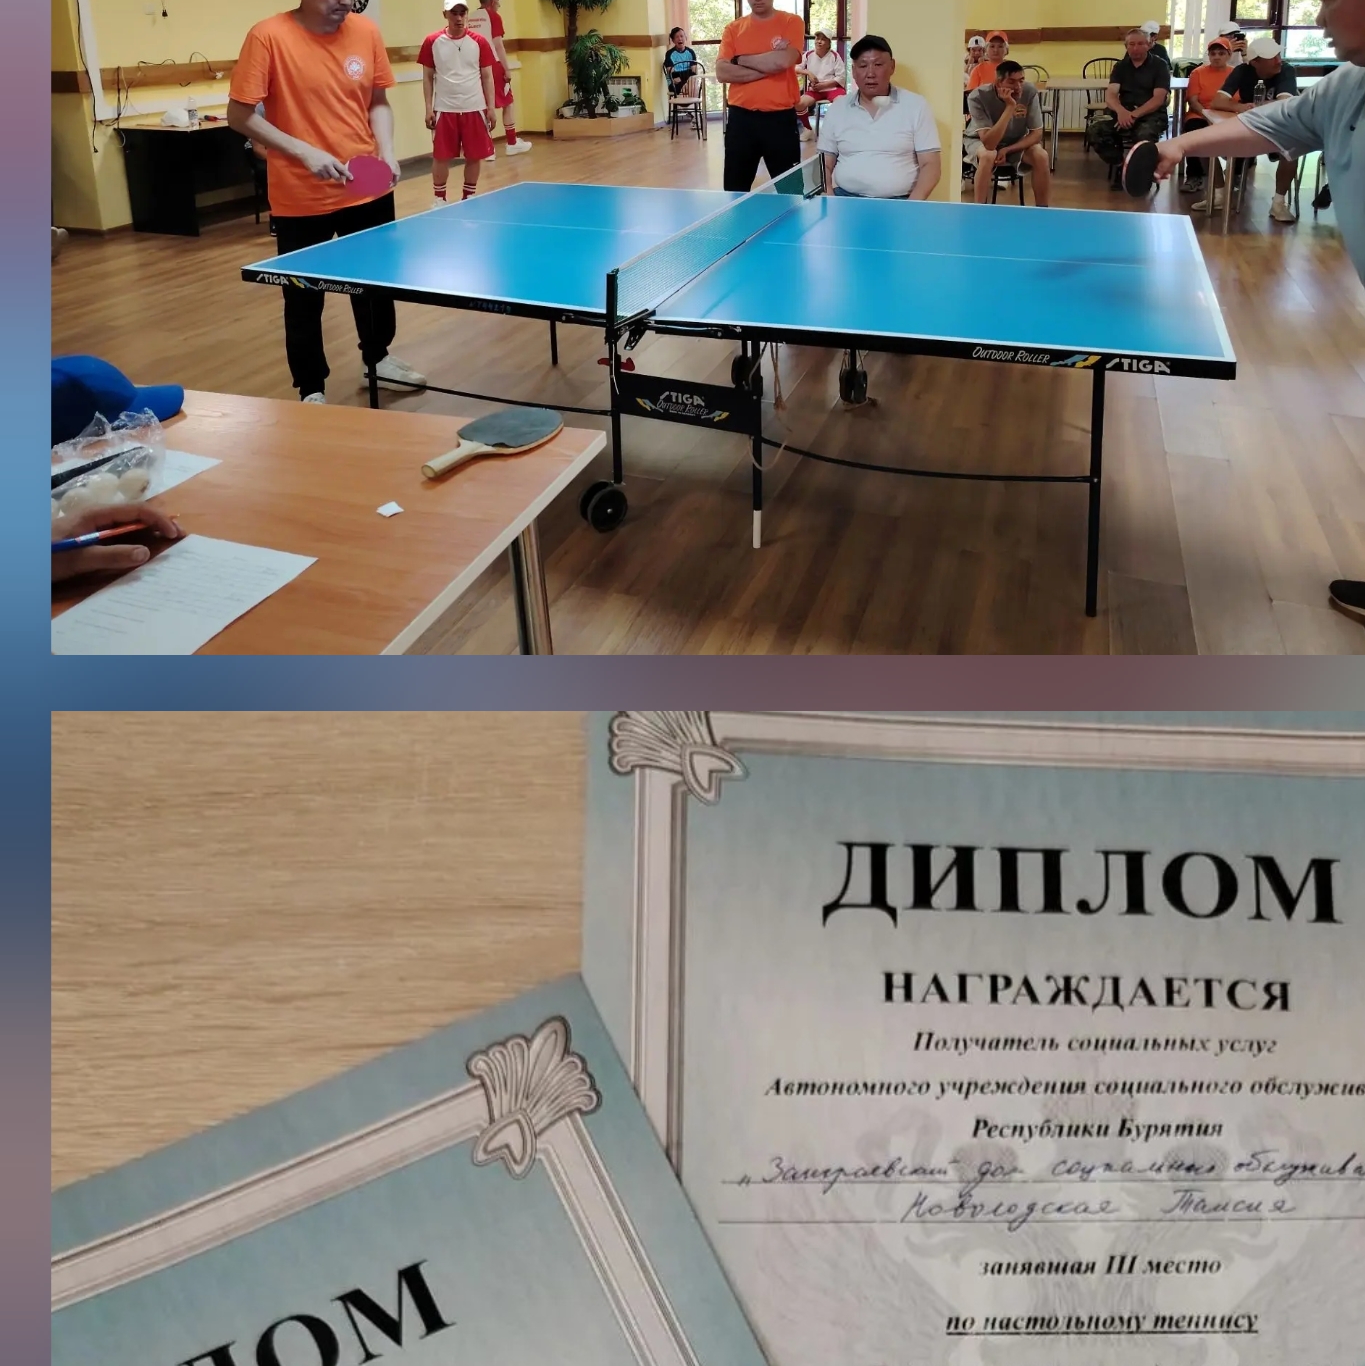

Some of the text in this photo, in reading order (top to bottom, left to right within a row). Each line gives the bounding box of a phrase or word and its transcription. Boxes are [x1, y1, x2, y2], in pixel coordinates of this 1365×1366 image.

[256, 273, 289, 286] STIGA
[1105, 358, 1171, 374] STIGA
[660, 391, 705, 407] STIGA
[822, 841, 1341, 928] ДИПЛОМ
[884, 971, 1290, 1012] НАГРАЖДАЕТСЯ
[914, 1031, 1278, 1058] Получатель социальных услуг
[764, 1078, 931, 1096] Автономного
[935, 1077, 1087, 1100] учреждения
[1093, 1079, 1243, 1099] социального
[972, 1117, 1223, 1143] Республики Бурятия
[982, 1254, 1222, 1276] занявшая III место
[945, 1314, 1259, 1334] по настольному теннису
